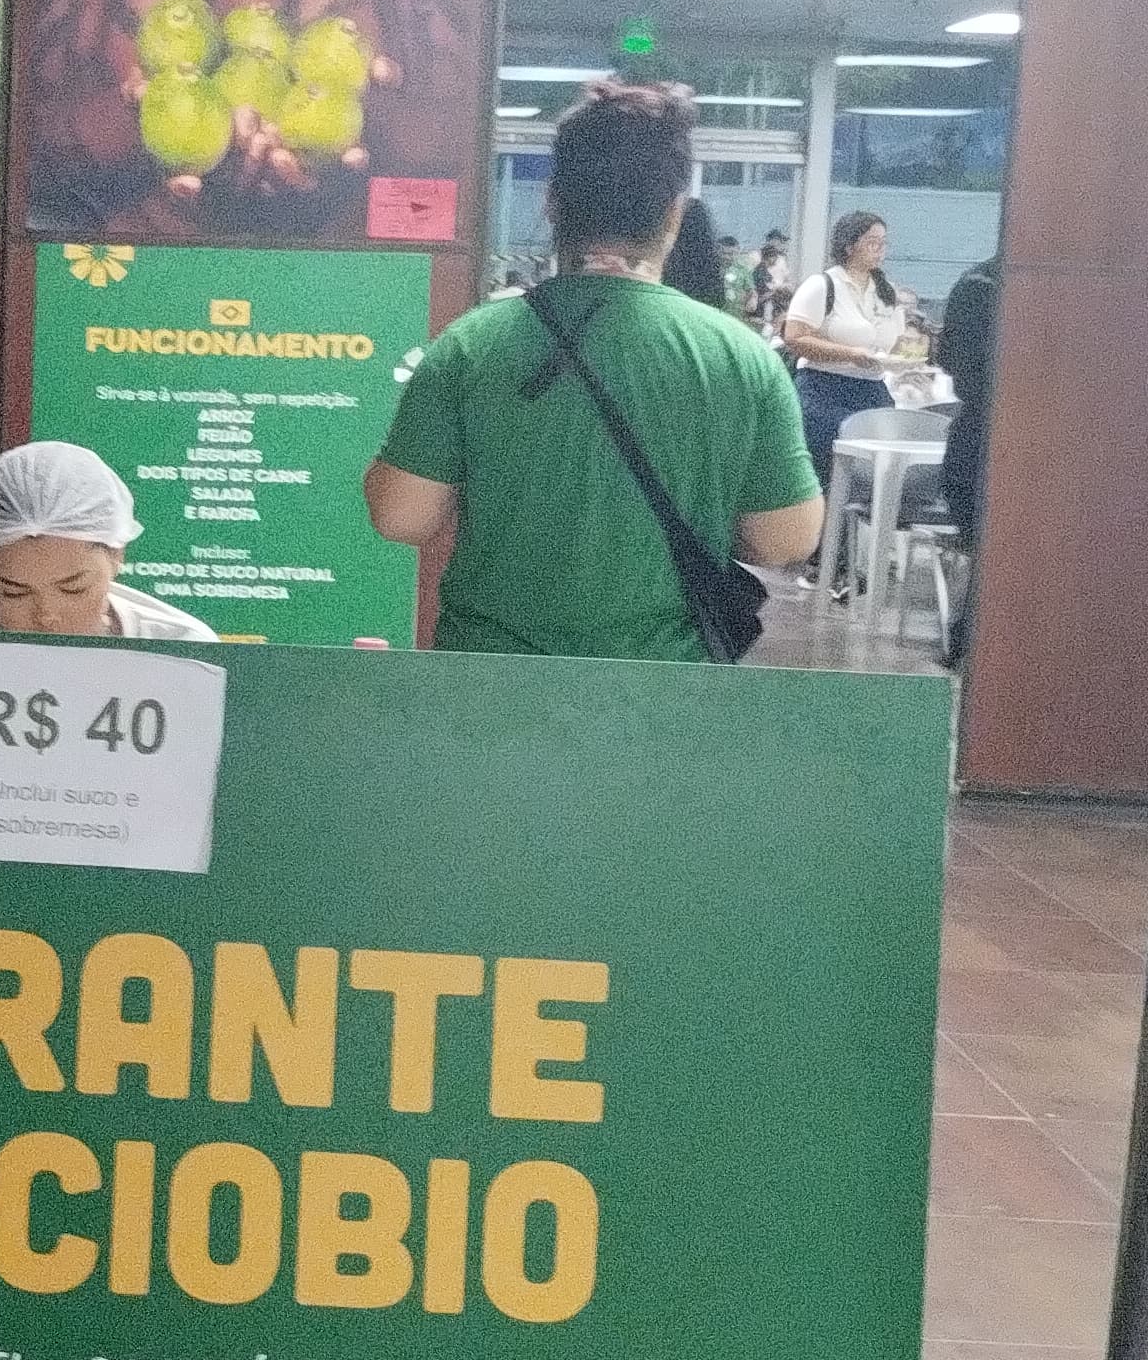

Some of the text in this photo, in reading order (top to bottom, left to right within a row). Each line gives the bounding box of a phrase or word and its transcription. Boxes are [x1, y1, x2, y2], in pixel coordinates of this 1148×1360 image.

[85, 326, 375, 359] FUNCIONAMENTO
[96, 385, 157, 401] Sirva-se
[172, 390, 241, 406] vontade,
[242, 393, 277, 405] sem
[197, 409, 255, 424] ARROZ
[197, 425, 253, 444] FEIJÃO
[186, 447, 263, 463] LEGUMES
[137, 465, 312, 484] DOIS TIPOS DE CARNE
[191, 487, 255, 502] SALADA
[184, 505, 261, 521] E FAROFA
[134, 563, 185, 577] COPO
[185, 564, 210, 578] DE
[210, 565, 259, 579] SUCO
[259, 566, 335, 582] NATURAL
[155, 582, 289, 599] UMA SOBREMESA
[85, 695, 166, 757] 40
[62, 784, 119, 809] suco
[124, 790, 141, 809] e
